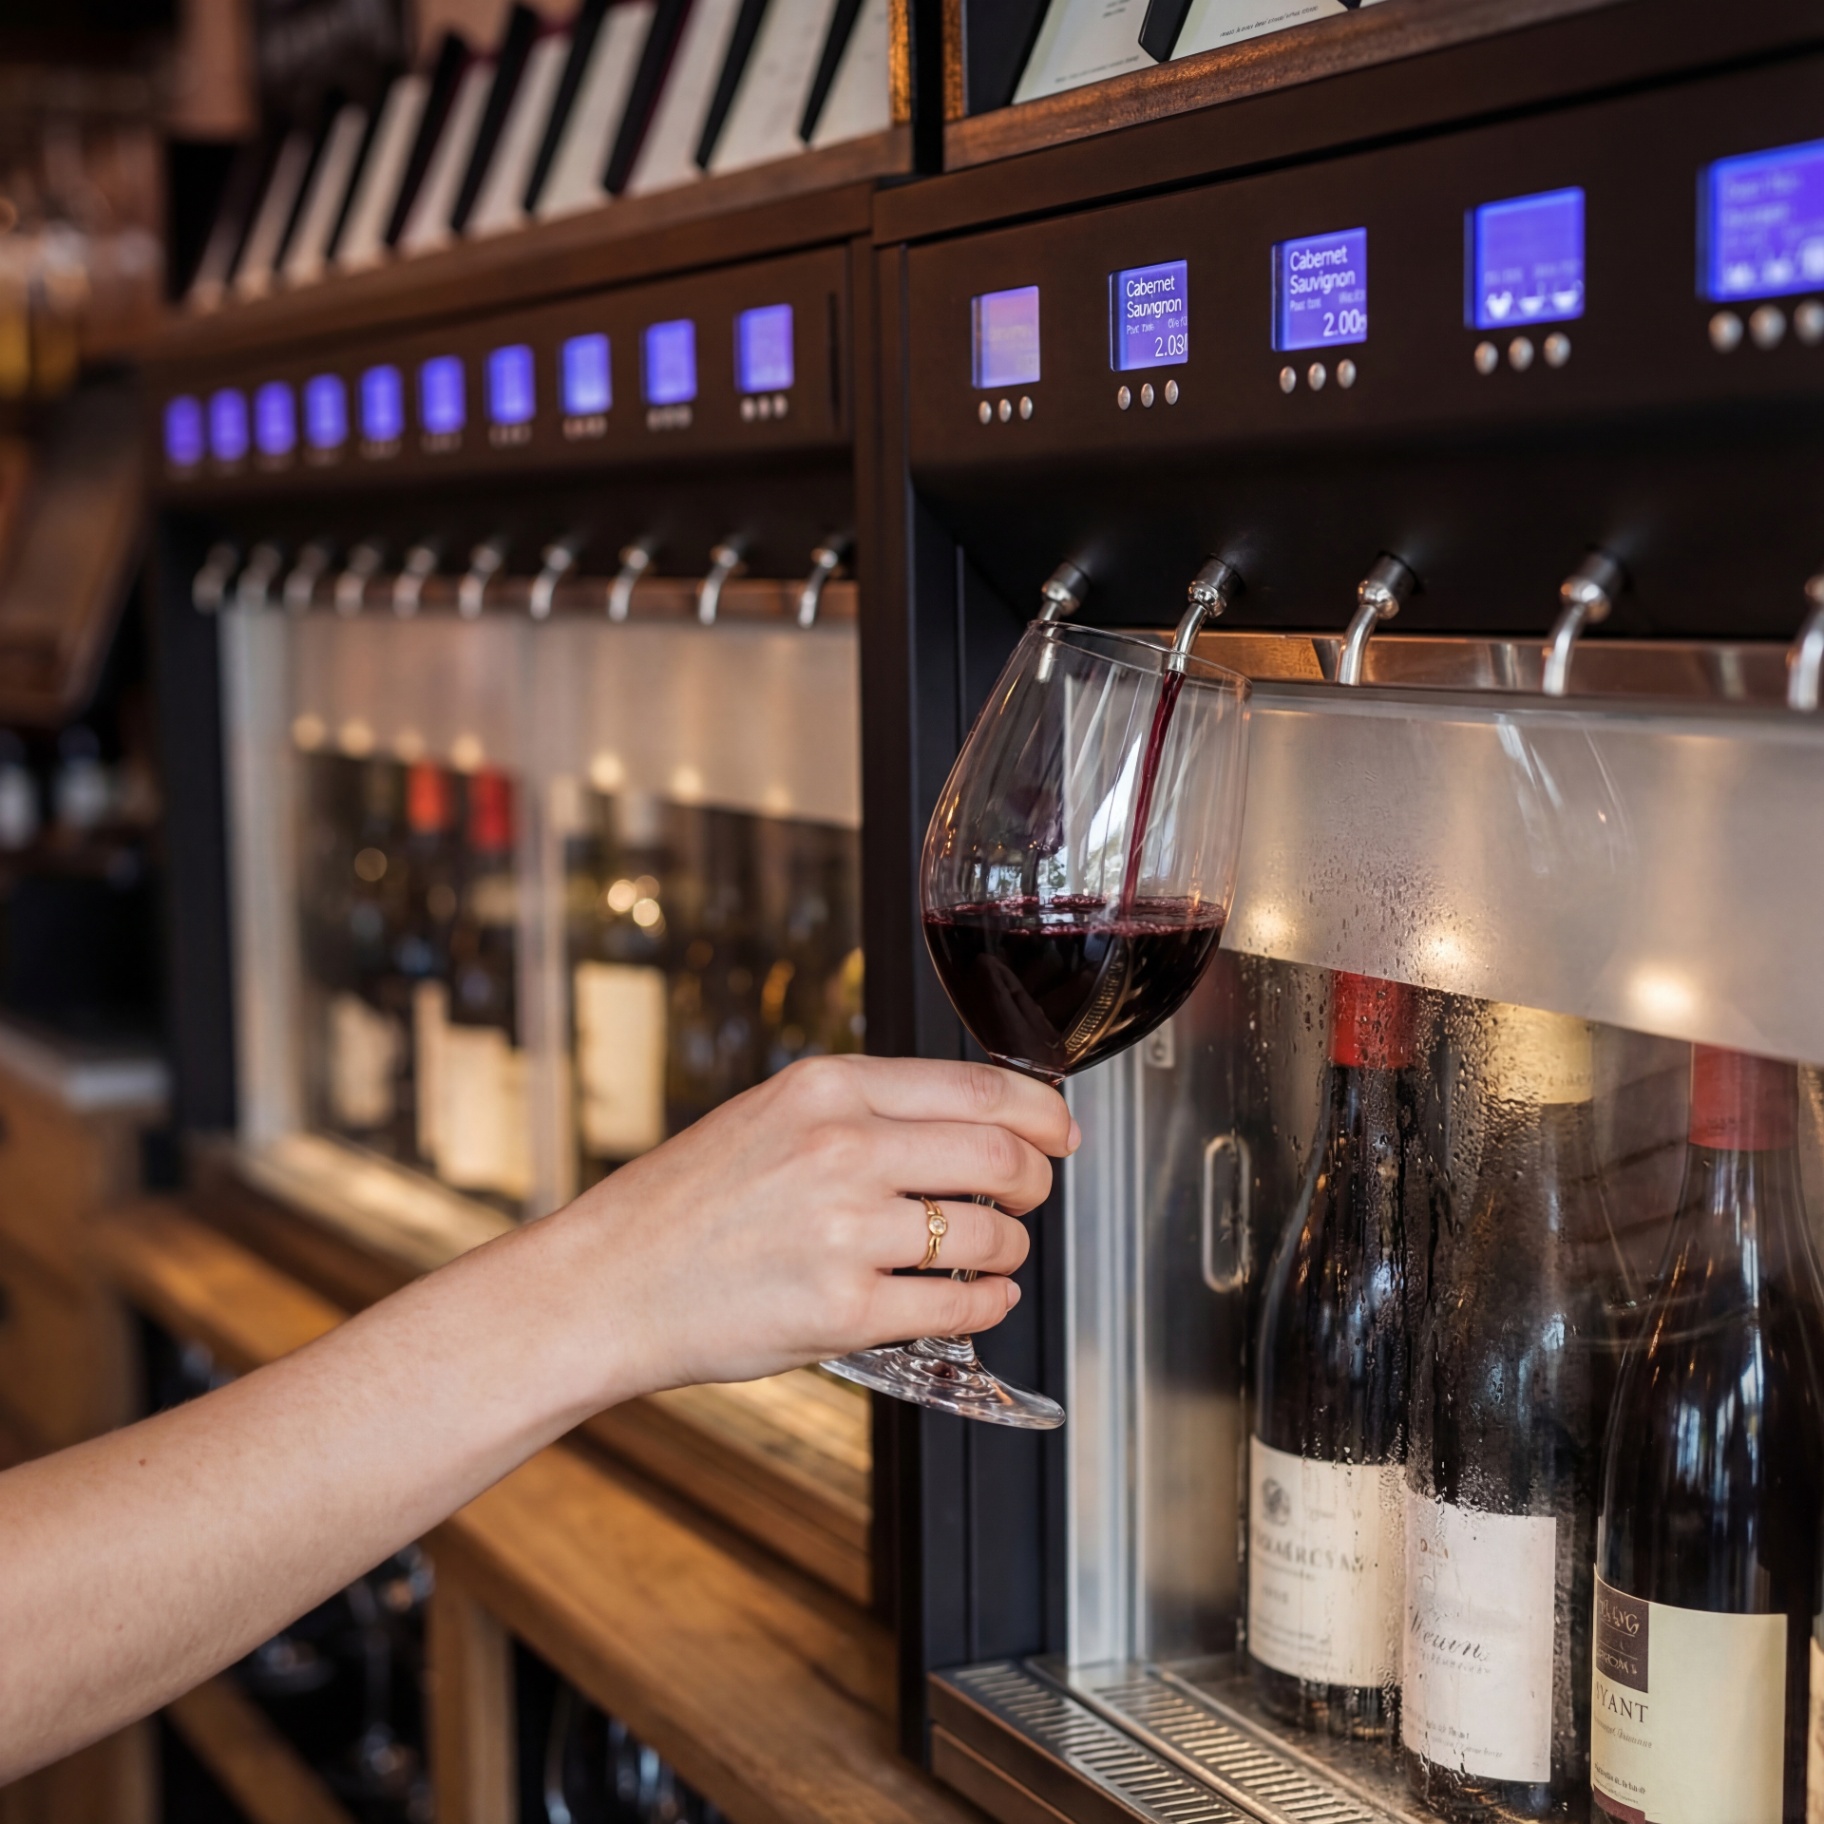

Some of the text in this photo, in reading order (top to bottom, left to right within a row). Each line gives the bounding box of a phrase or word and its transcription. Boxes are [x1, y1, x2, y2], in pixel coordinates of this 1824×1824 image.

[1289, 245, 1348, 272] Cabernet
[1126, 275, 1175, 297] Cabernet
[1290, 270, 1356, 295] Sauvignon
[1126, 298, 1182, 318] Sauvignon
